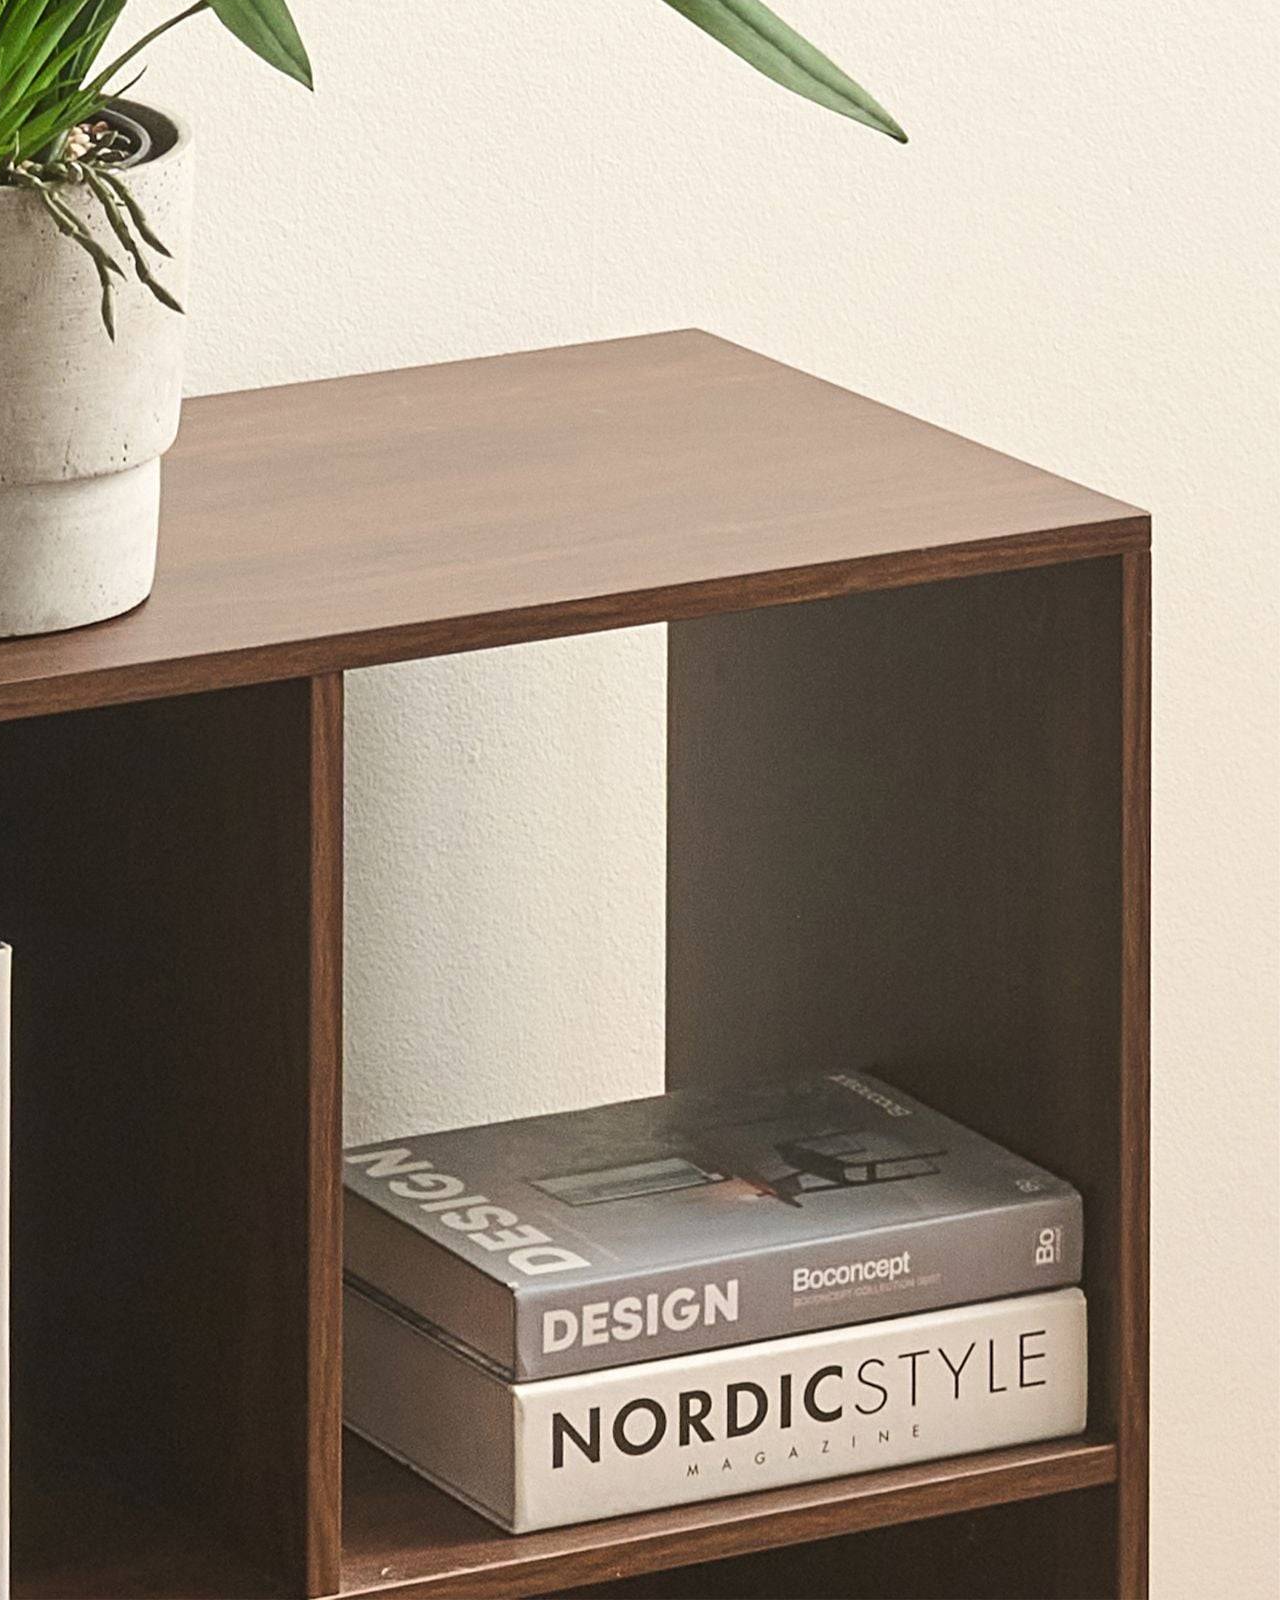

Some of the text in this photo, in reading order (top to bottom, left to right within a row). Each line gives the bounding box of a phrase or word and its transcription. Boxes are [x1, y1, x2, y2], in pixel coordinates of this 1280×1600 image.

[345, 1148, 592, 1276] DESIGN
[792, 1251, 912, 1293] Boconcept
[1036, 1228, 1055, 1265] Bo
[542, 1278, 739, 1354] DESIGN
[552, 1330, 1047, 1469] NORDICSTYLE
[686, 1425, 921, 1477] MAGAZINE
